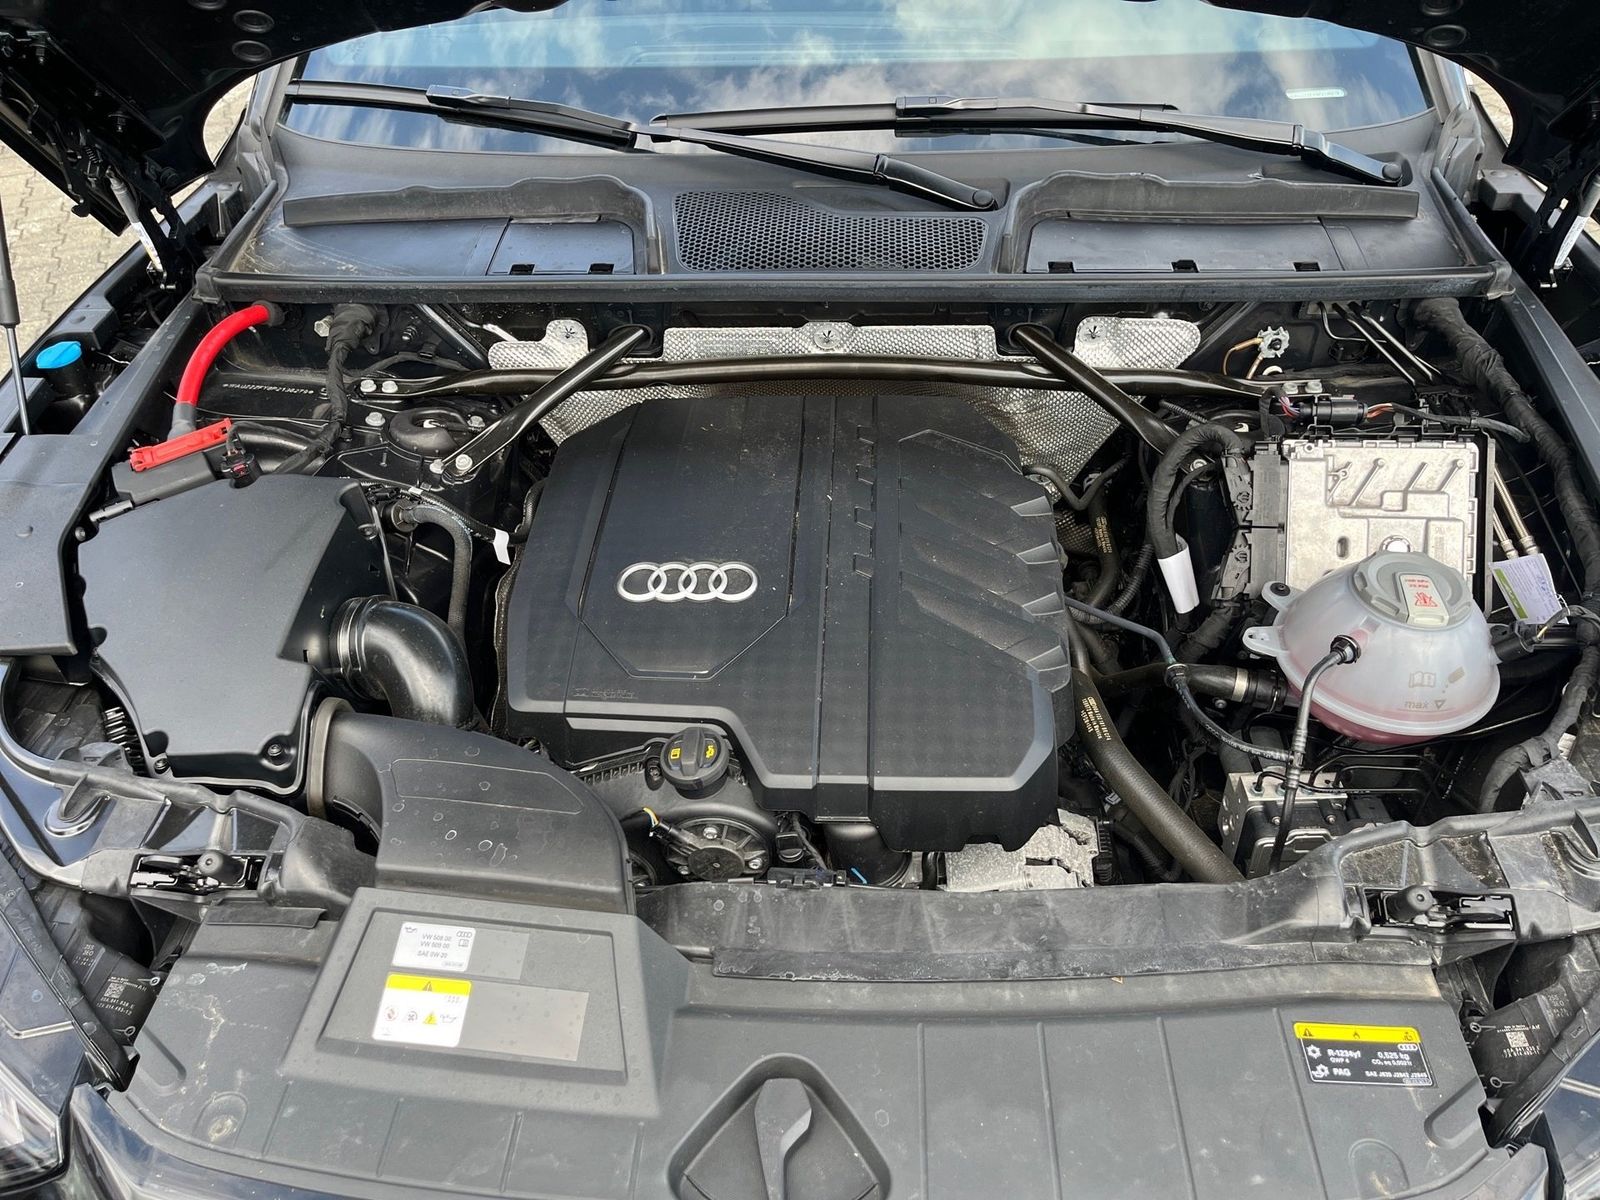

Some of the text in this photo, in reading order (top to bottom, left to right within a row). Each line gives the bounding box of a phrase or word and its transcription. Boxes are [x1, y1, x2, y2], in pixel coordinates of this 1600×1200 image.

[1404, 700, 1429, 709] max
[1327, 1049, 1361, 1059] R-1234yf
[1399, 1052, 1410, 1060] kg
[1332, 1068, 1351, 1076] PAG
